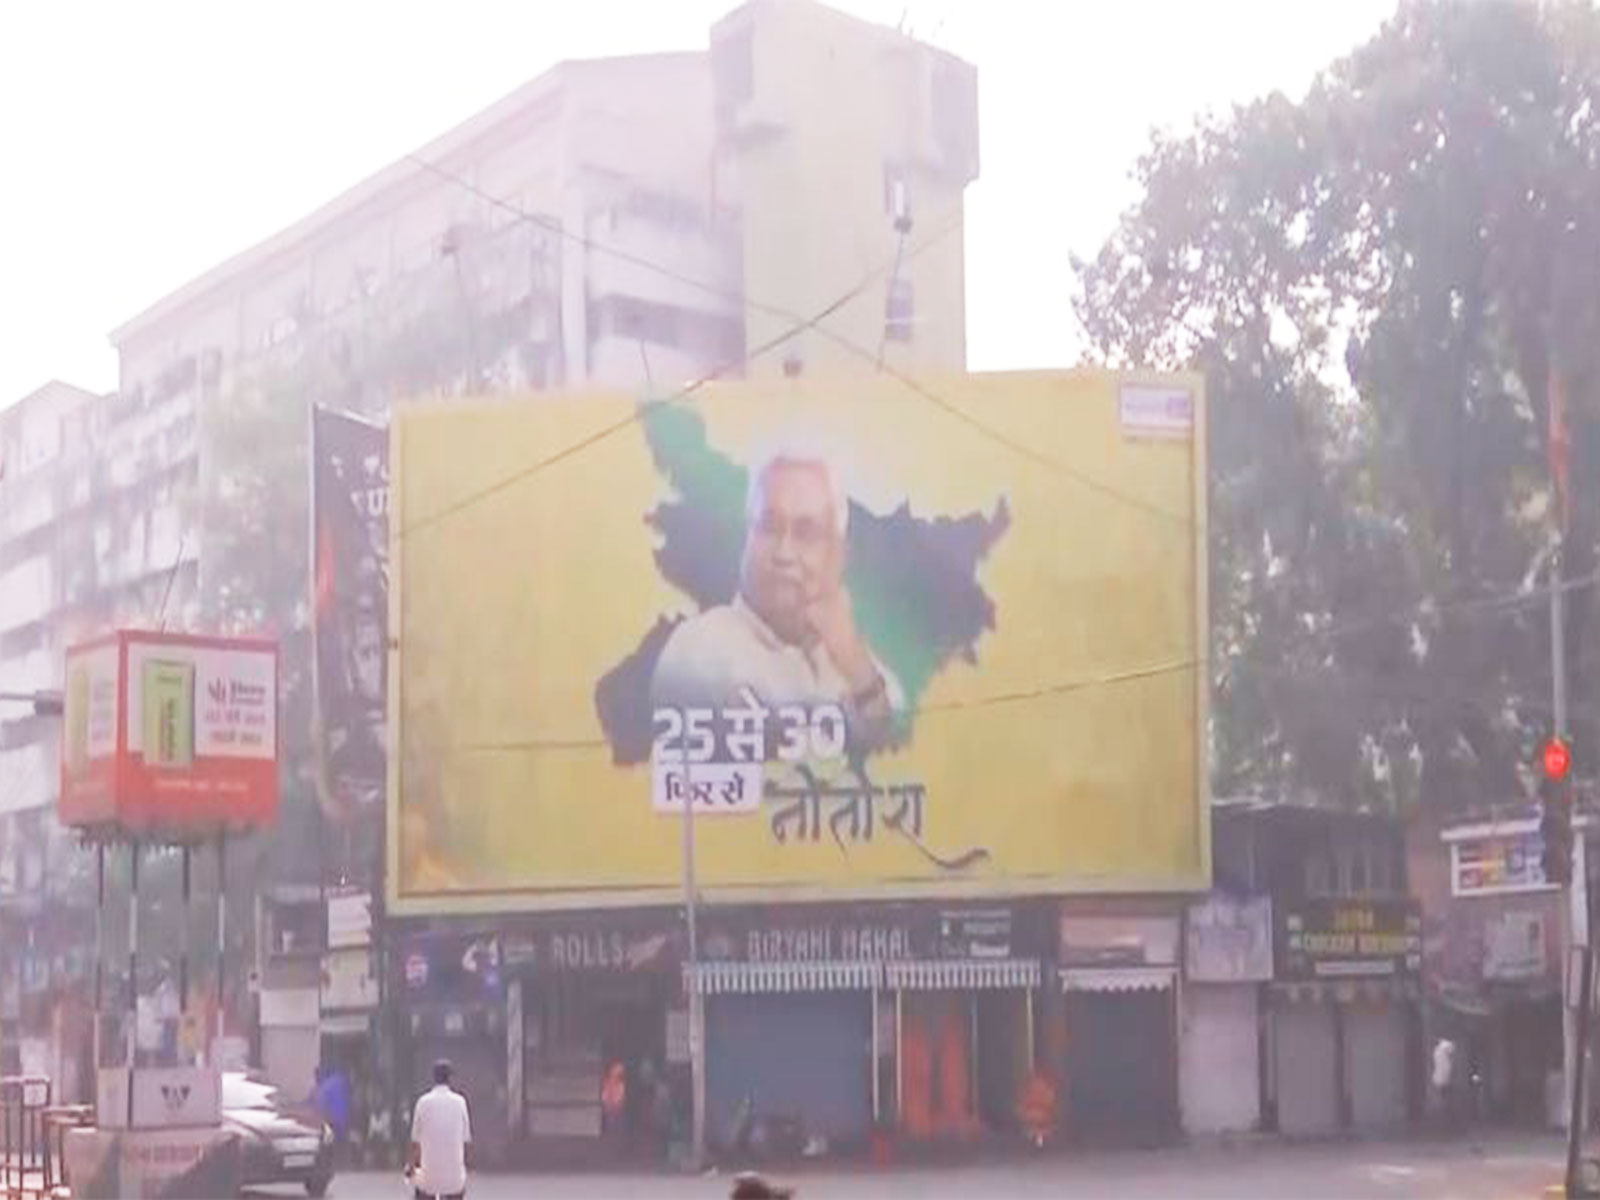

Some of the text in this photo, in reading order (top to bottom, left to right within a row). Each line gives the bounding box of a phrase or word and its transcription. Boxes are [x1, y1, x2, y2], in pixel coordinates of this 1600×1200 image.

[652, 686, 846, 763] 25 से 30
[720, 771, 745, 805] से
[551, 932, 624, 970] ROLLS
[747, 929, 831, 961] BIRYANI
[841, 929, 911, 961] MAHAL
